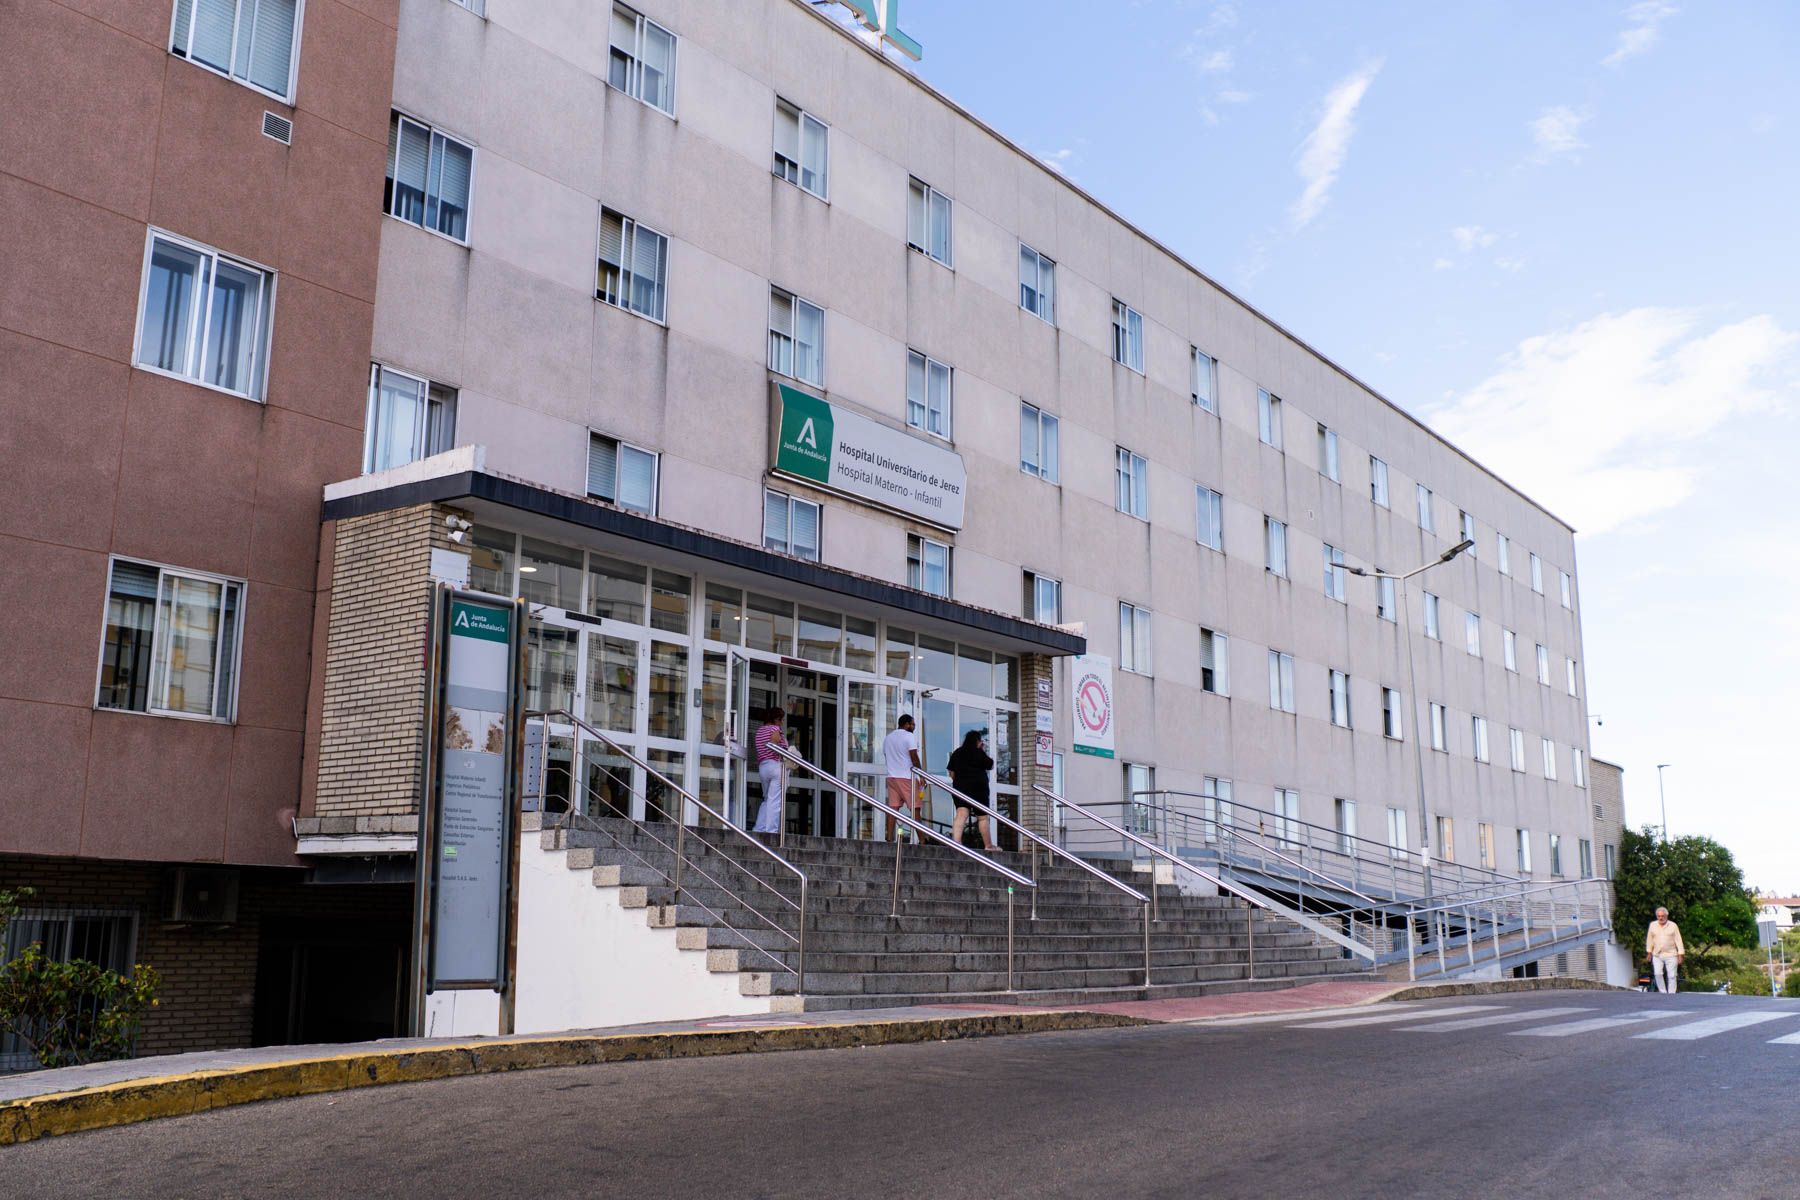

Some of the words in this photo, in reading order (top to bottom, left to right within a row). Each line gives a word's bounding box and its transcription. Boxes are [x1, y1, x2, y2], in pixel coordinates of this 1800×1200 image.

[784, 441, 798, 452] Junta
[798, 446, 804, 454] de
[839, 441, 875, 465] Hospital
[876, 454, 928, 483] Universitario
[928, 474, 939, 487] de
[939, 479, 960, 495] Jerez
[837, 462, 873, 485] Hospital
[874, 475, 909, 497] Materno
[914, 489, 942, 509] Infantil
[471, 614, 487, 622] Junta
